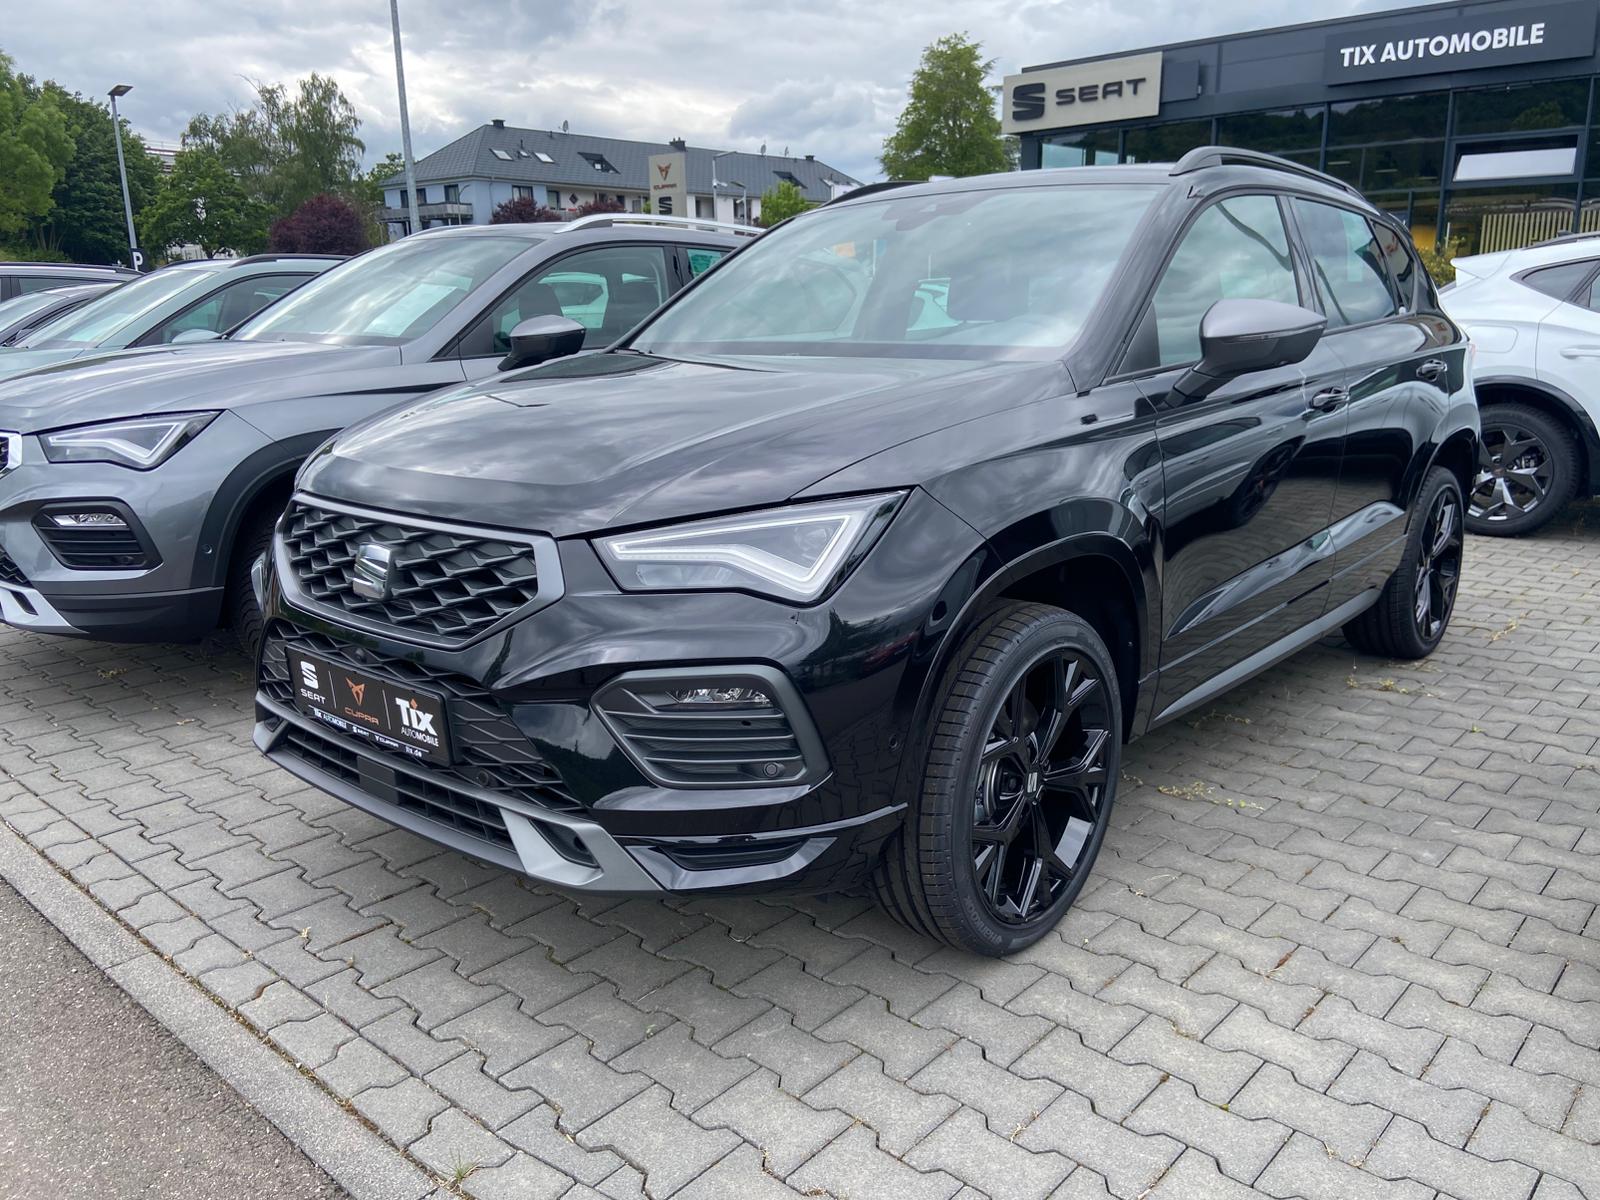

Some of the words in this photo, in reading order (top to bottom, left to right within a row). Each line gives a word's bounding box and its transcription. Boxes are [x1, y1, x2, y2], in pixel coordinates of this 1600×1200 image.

[1340, 44, 1377, 67] TIX
[1380, 22, 1546, 63] AUTOMOBILE
[1055, 77, 1147, 106] SEAT
[132, 251, 144, 272] P
[300, 687, 326, 705] SEAT
[344, 706, 380, 726] CUPRA
[401, 727, 440, 747] AUTOMOBILE
